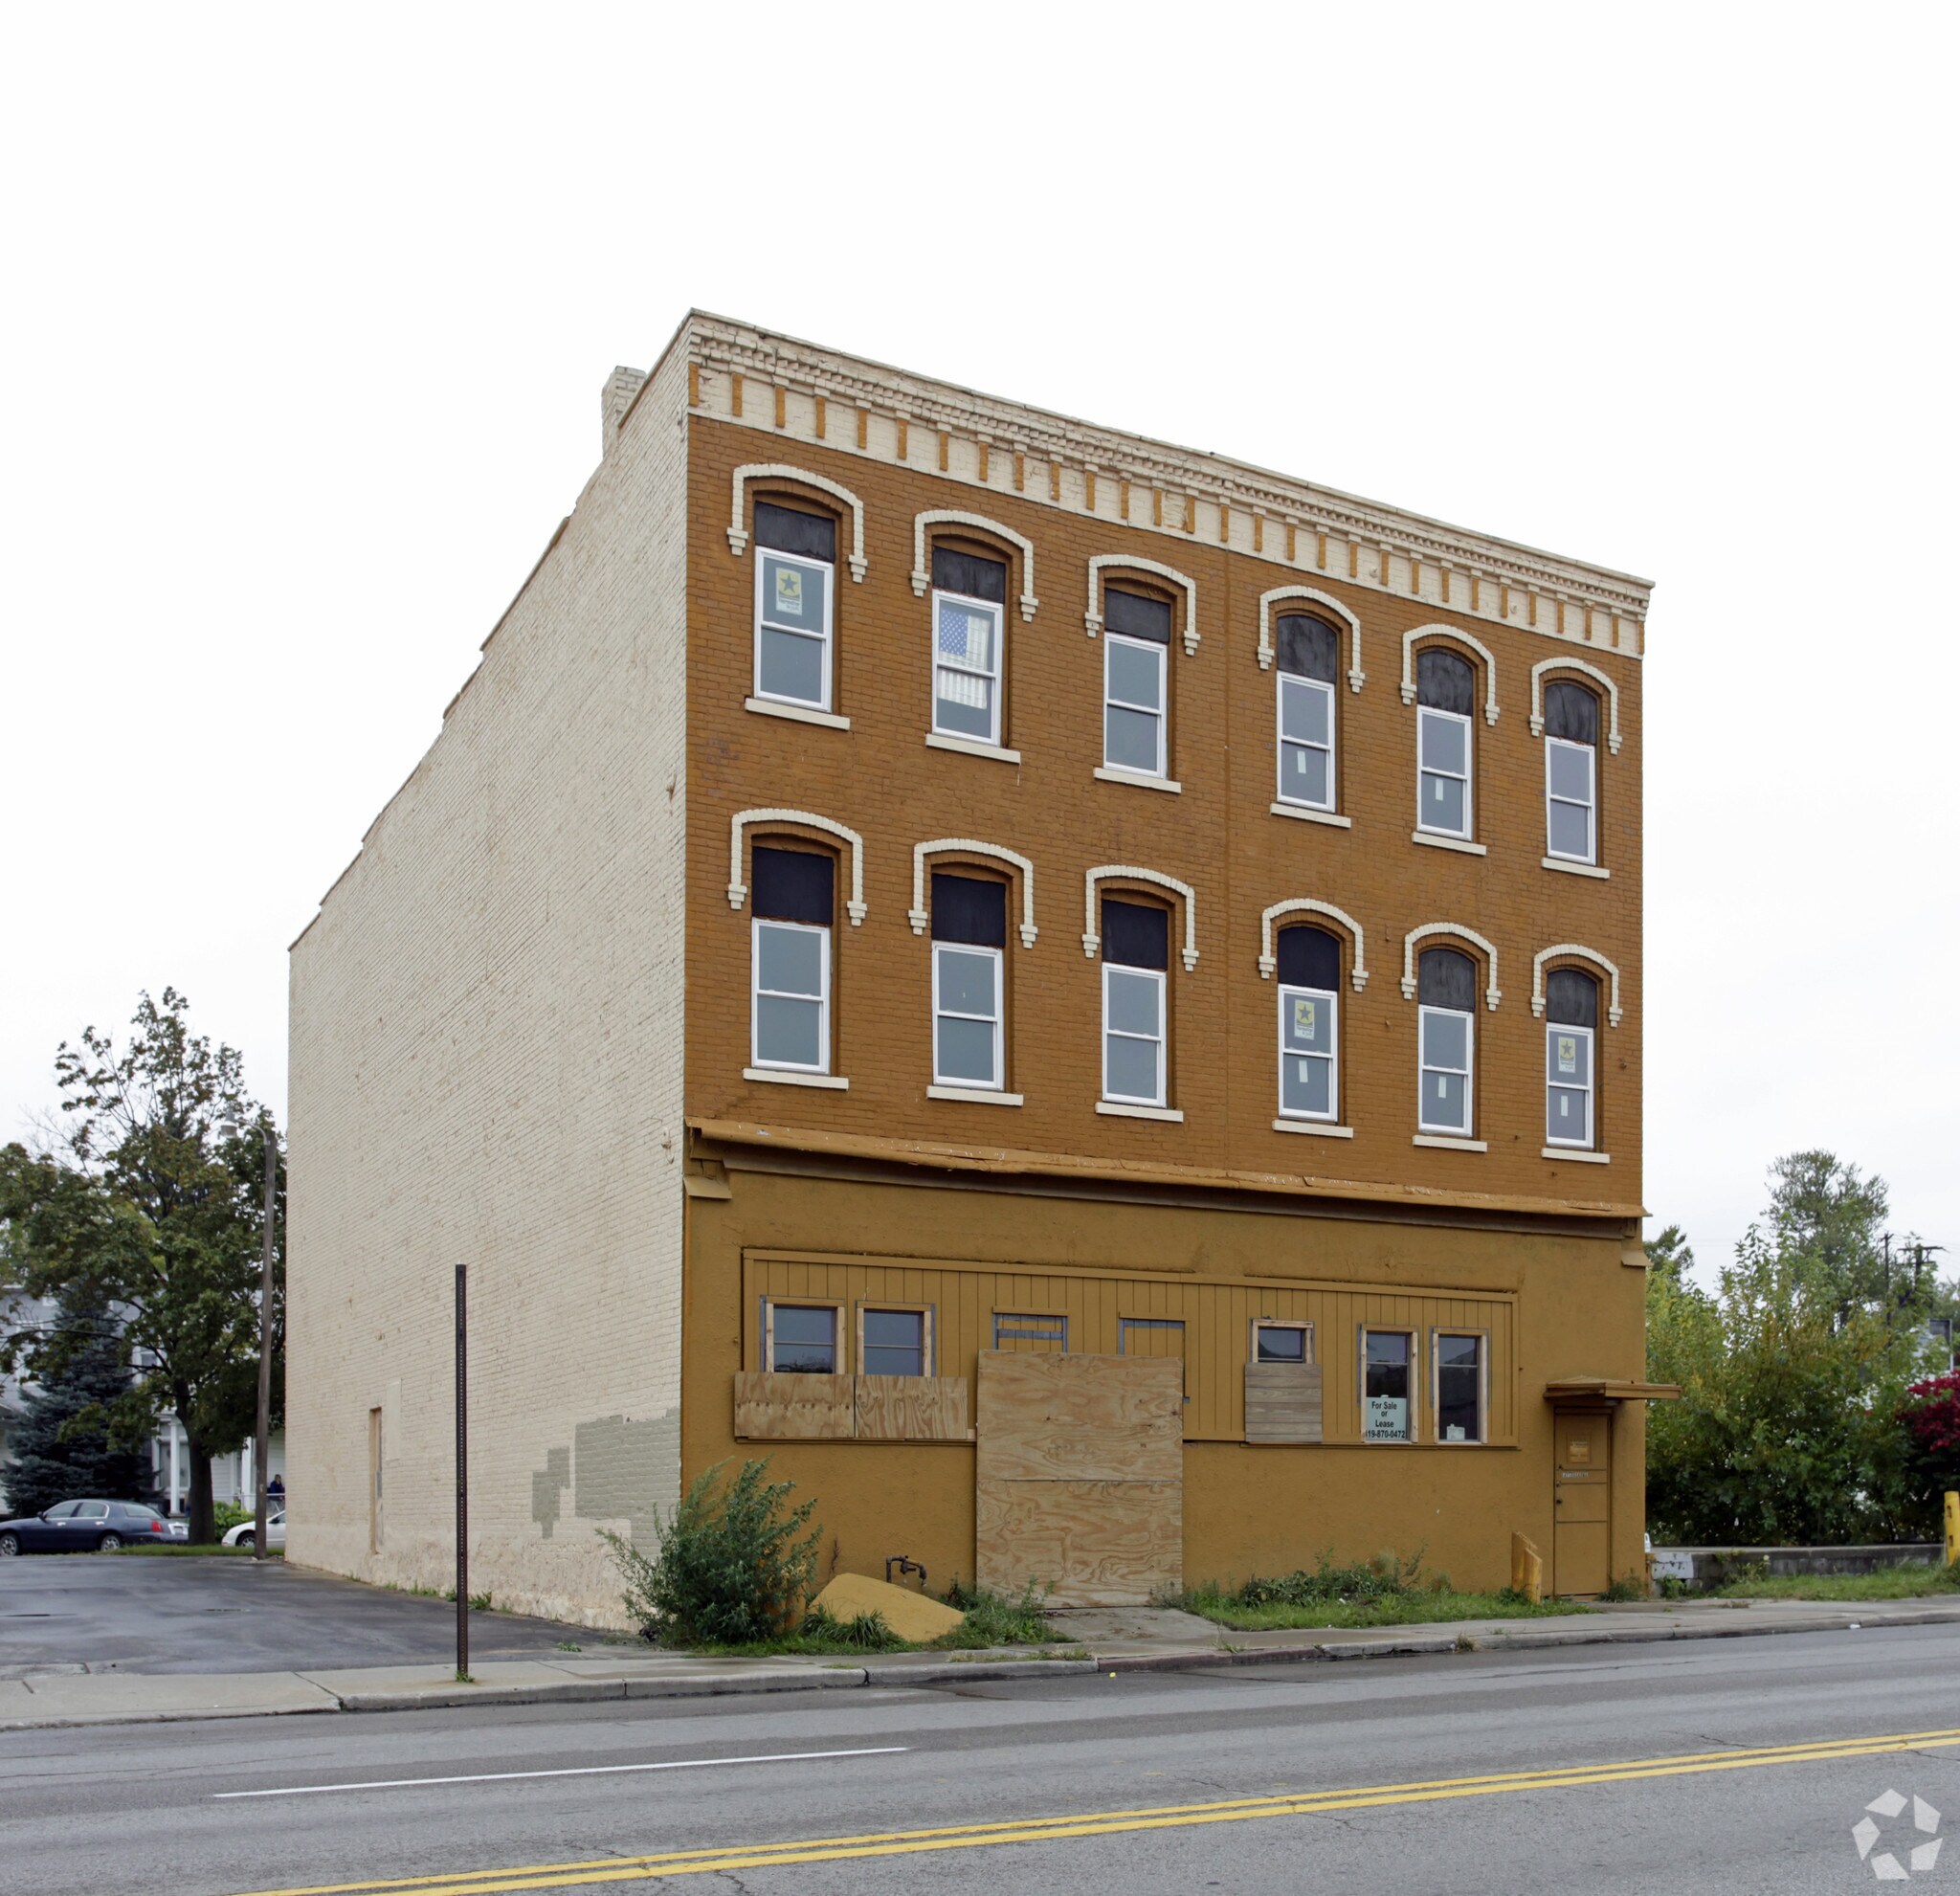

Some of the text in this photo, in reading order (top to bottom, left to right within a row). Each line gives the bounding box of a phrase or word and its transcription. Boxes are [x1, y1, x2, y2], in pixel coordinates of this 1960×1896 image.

[1371, 1401, 1397, 1410] For Sale
[1375, 1419, 1394, 1428] Lease
